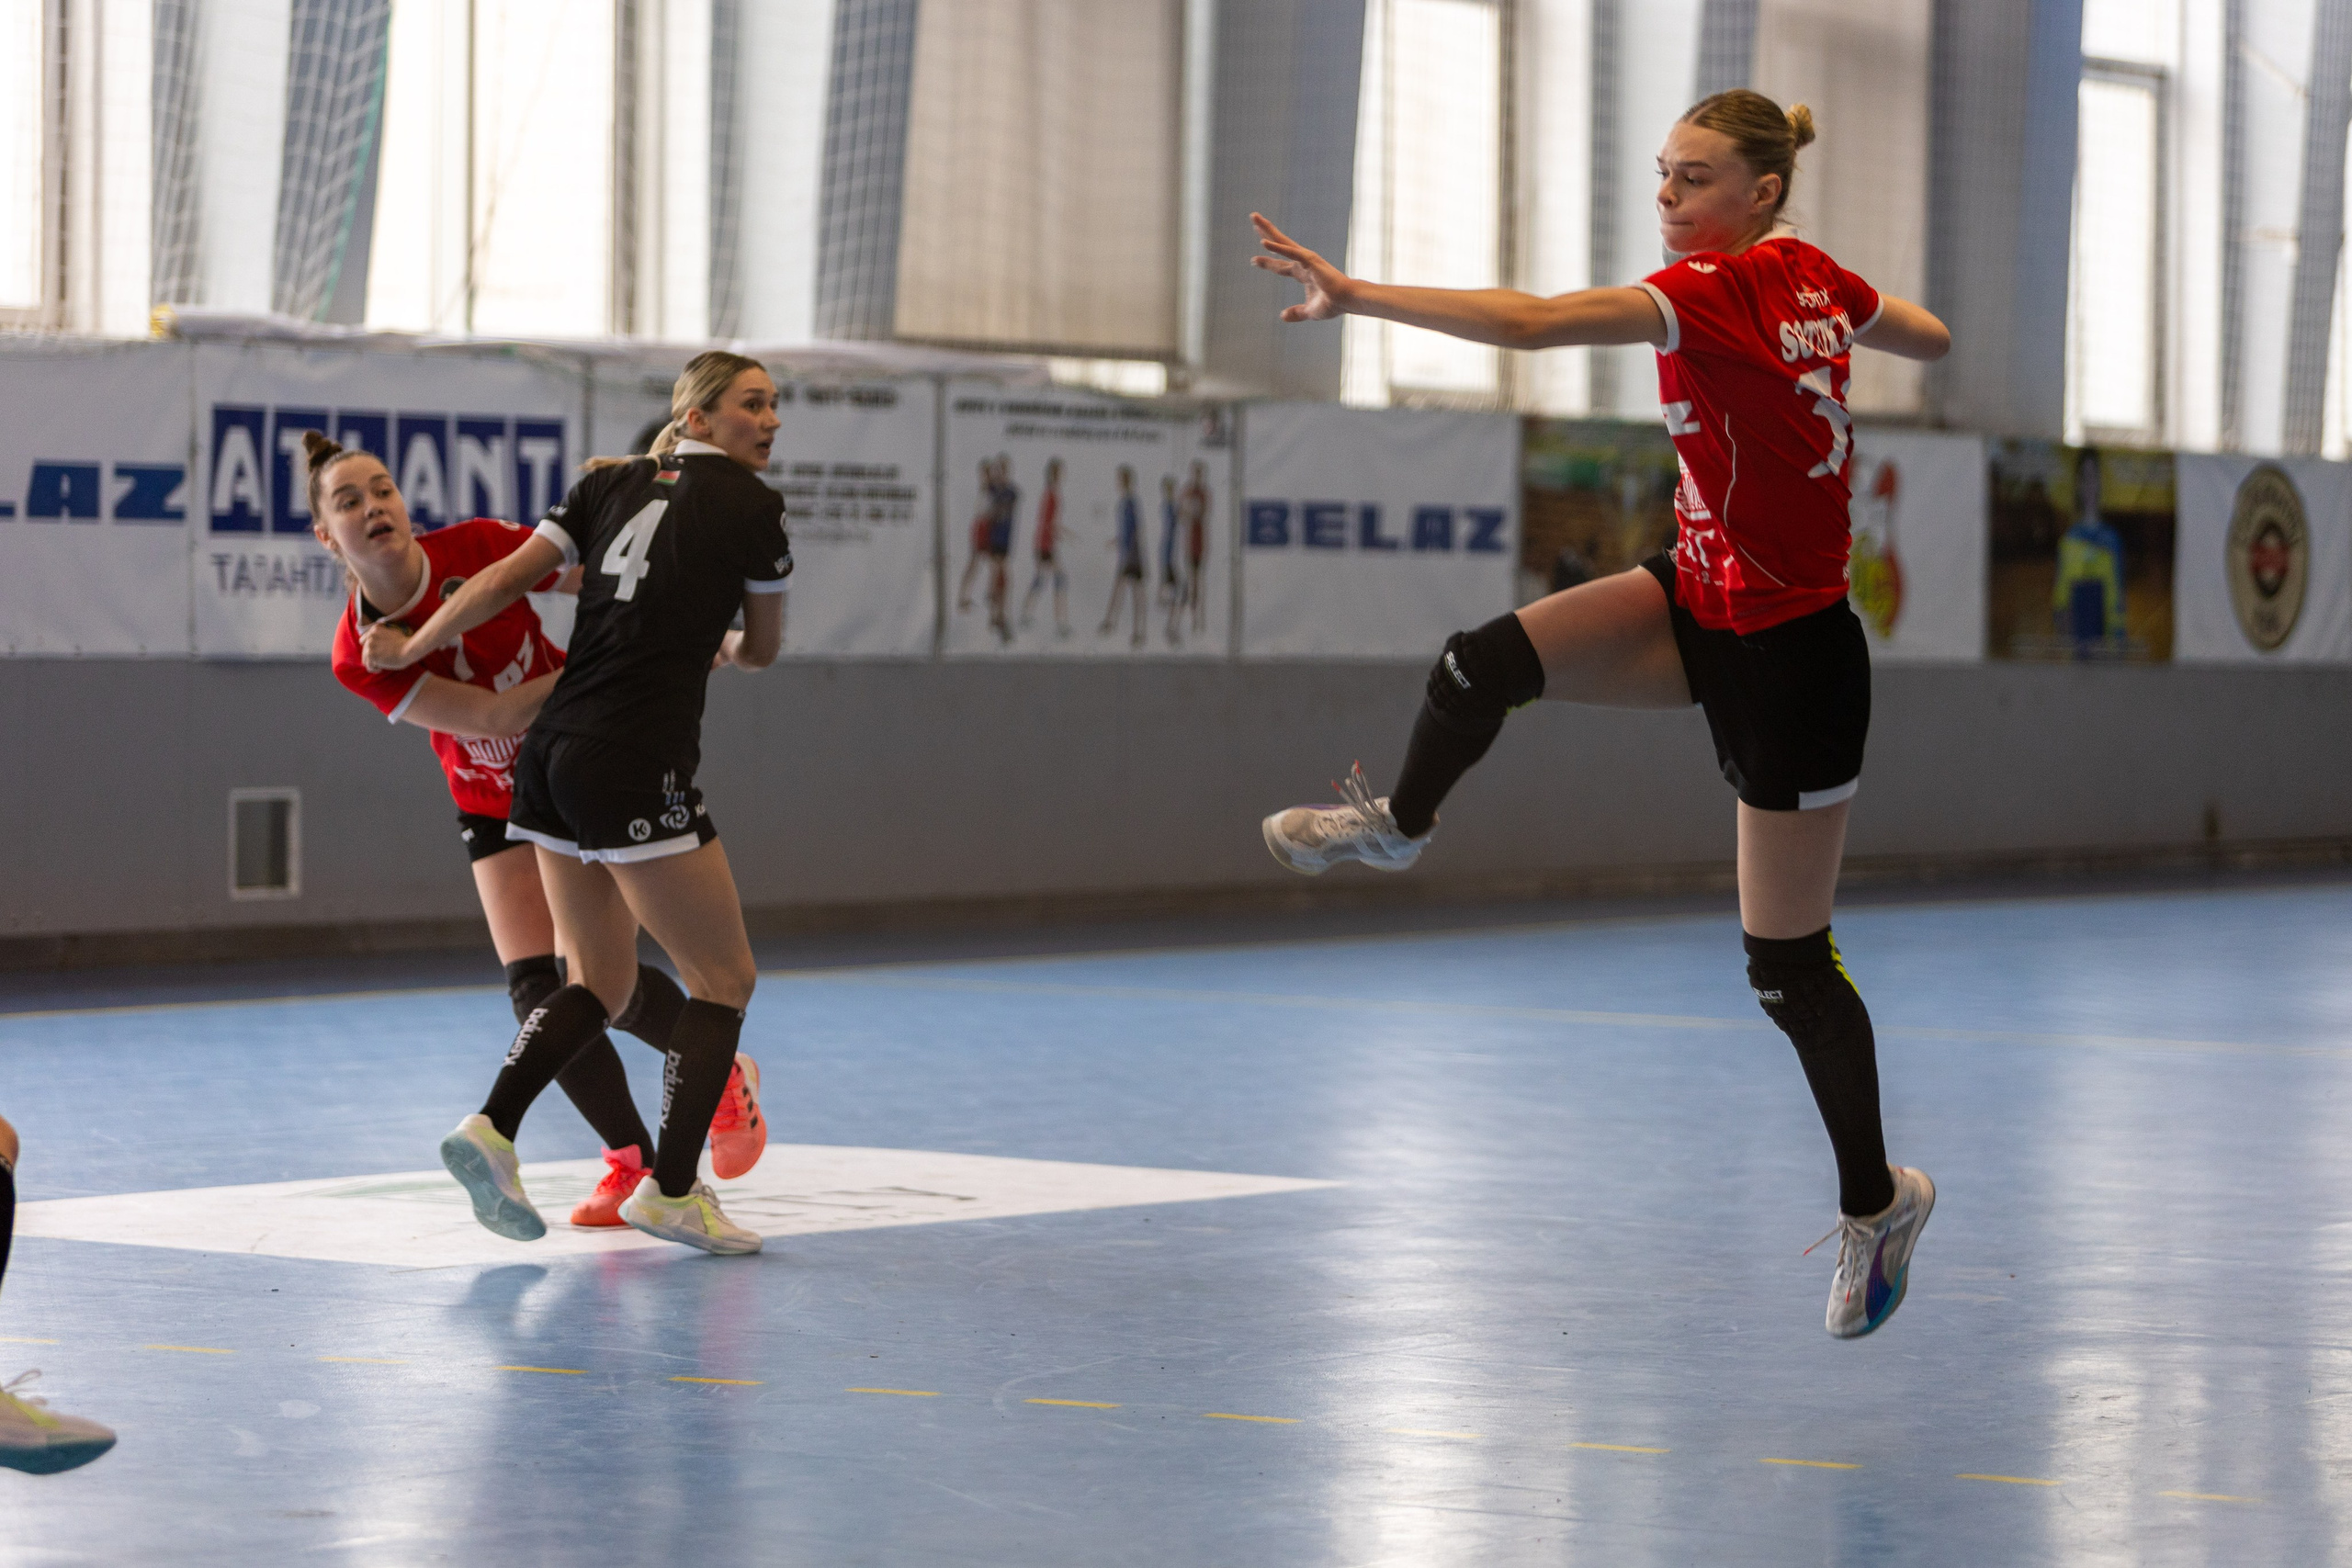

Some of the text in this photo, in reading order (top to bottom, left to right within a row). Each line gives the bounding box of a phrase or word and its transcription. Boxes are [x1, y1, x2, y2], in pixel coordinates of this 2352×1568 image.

[0, 461, 187, 523] AZ
[212, 424, 560, 520] ATANT
[600, 499, 669, 602] 4
[1247, 502, 1506, 551] BELAZ
